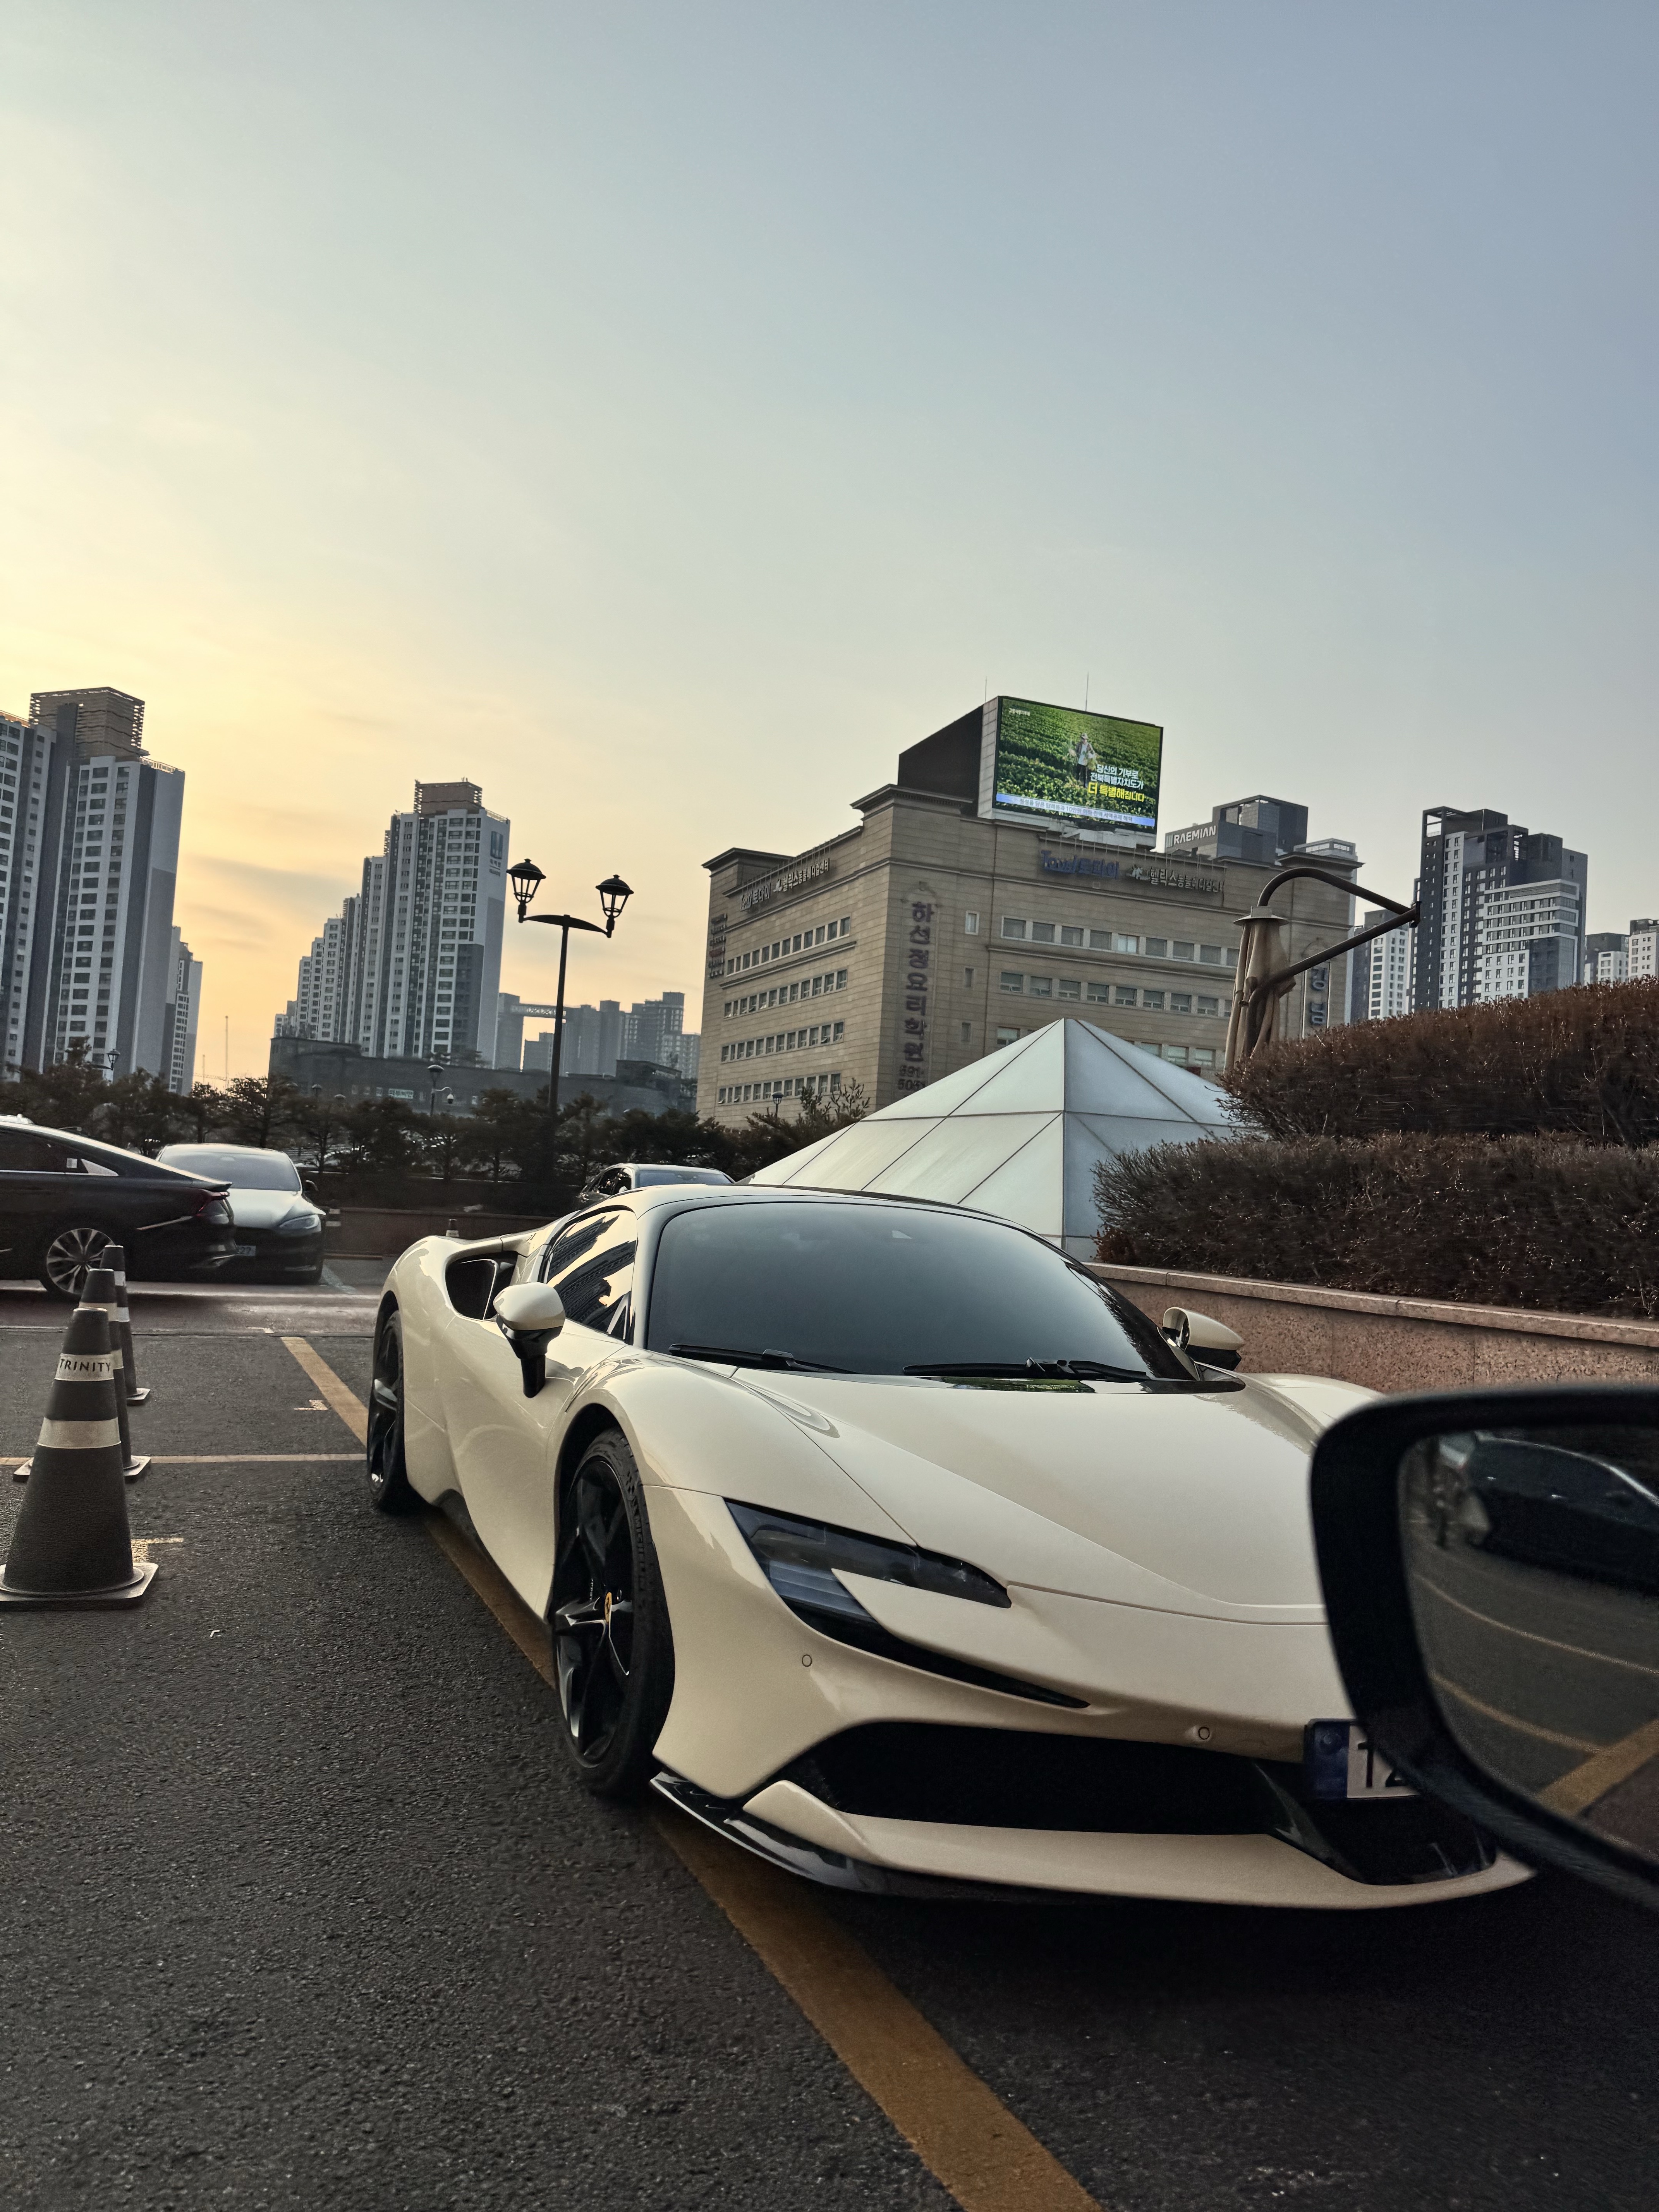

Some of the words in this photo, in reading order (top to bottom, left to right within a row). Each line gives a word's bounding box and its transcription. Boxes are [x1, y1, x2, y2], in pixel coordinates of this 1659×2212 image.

[1097, 764, 1117, 776] 당신의
[1118, 768, 1139, 779] 기부로
[1090, 772, 1144, 790] 전북특별자치도가
[1088, 781, 1098, 795] 더
[1099, 785, 1145, 802] 특별해집니다
[1173, 825, 1217, 844] RAEMIAN
[59, 1358, 111, 1372] TRINITY
